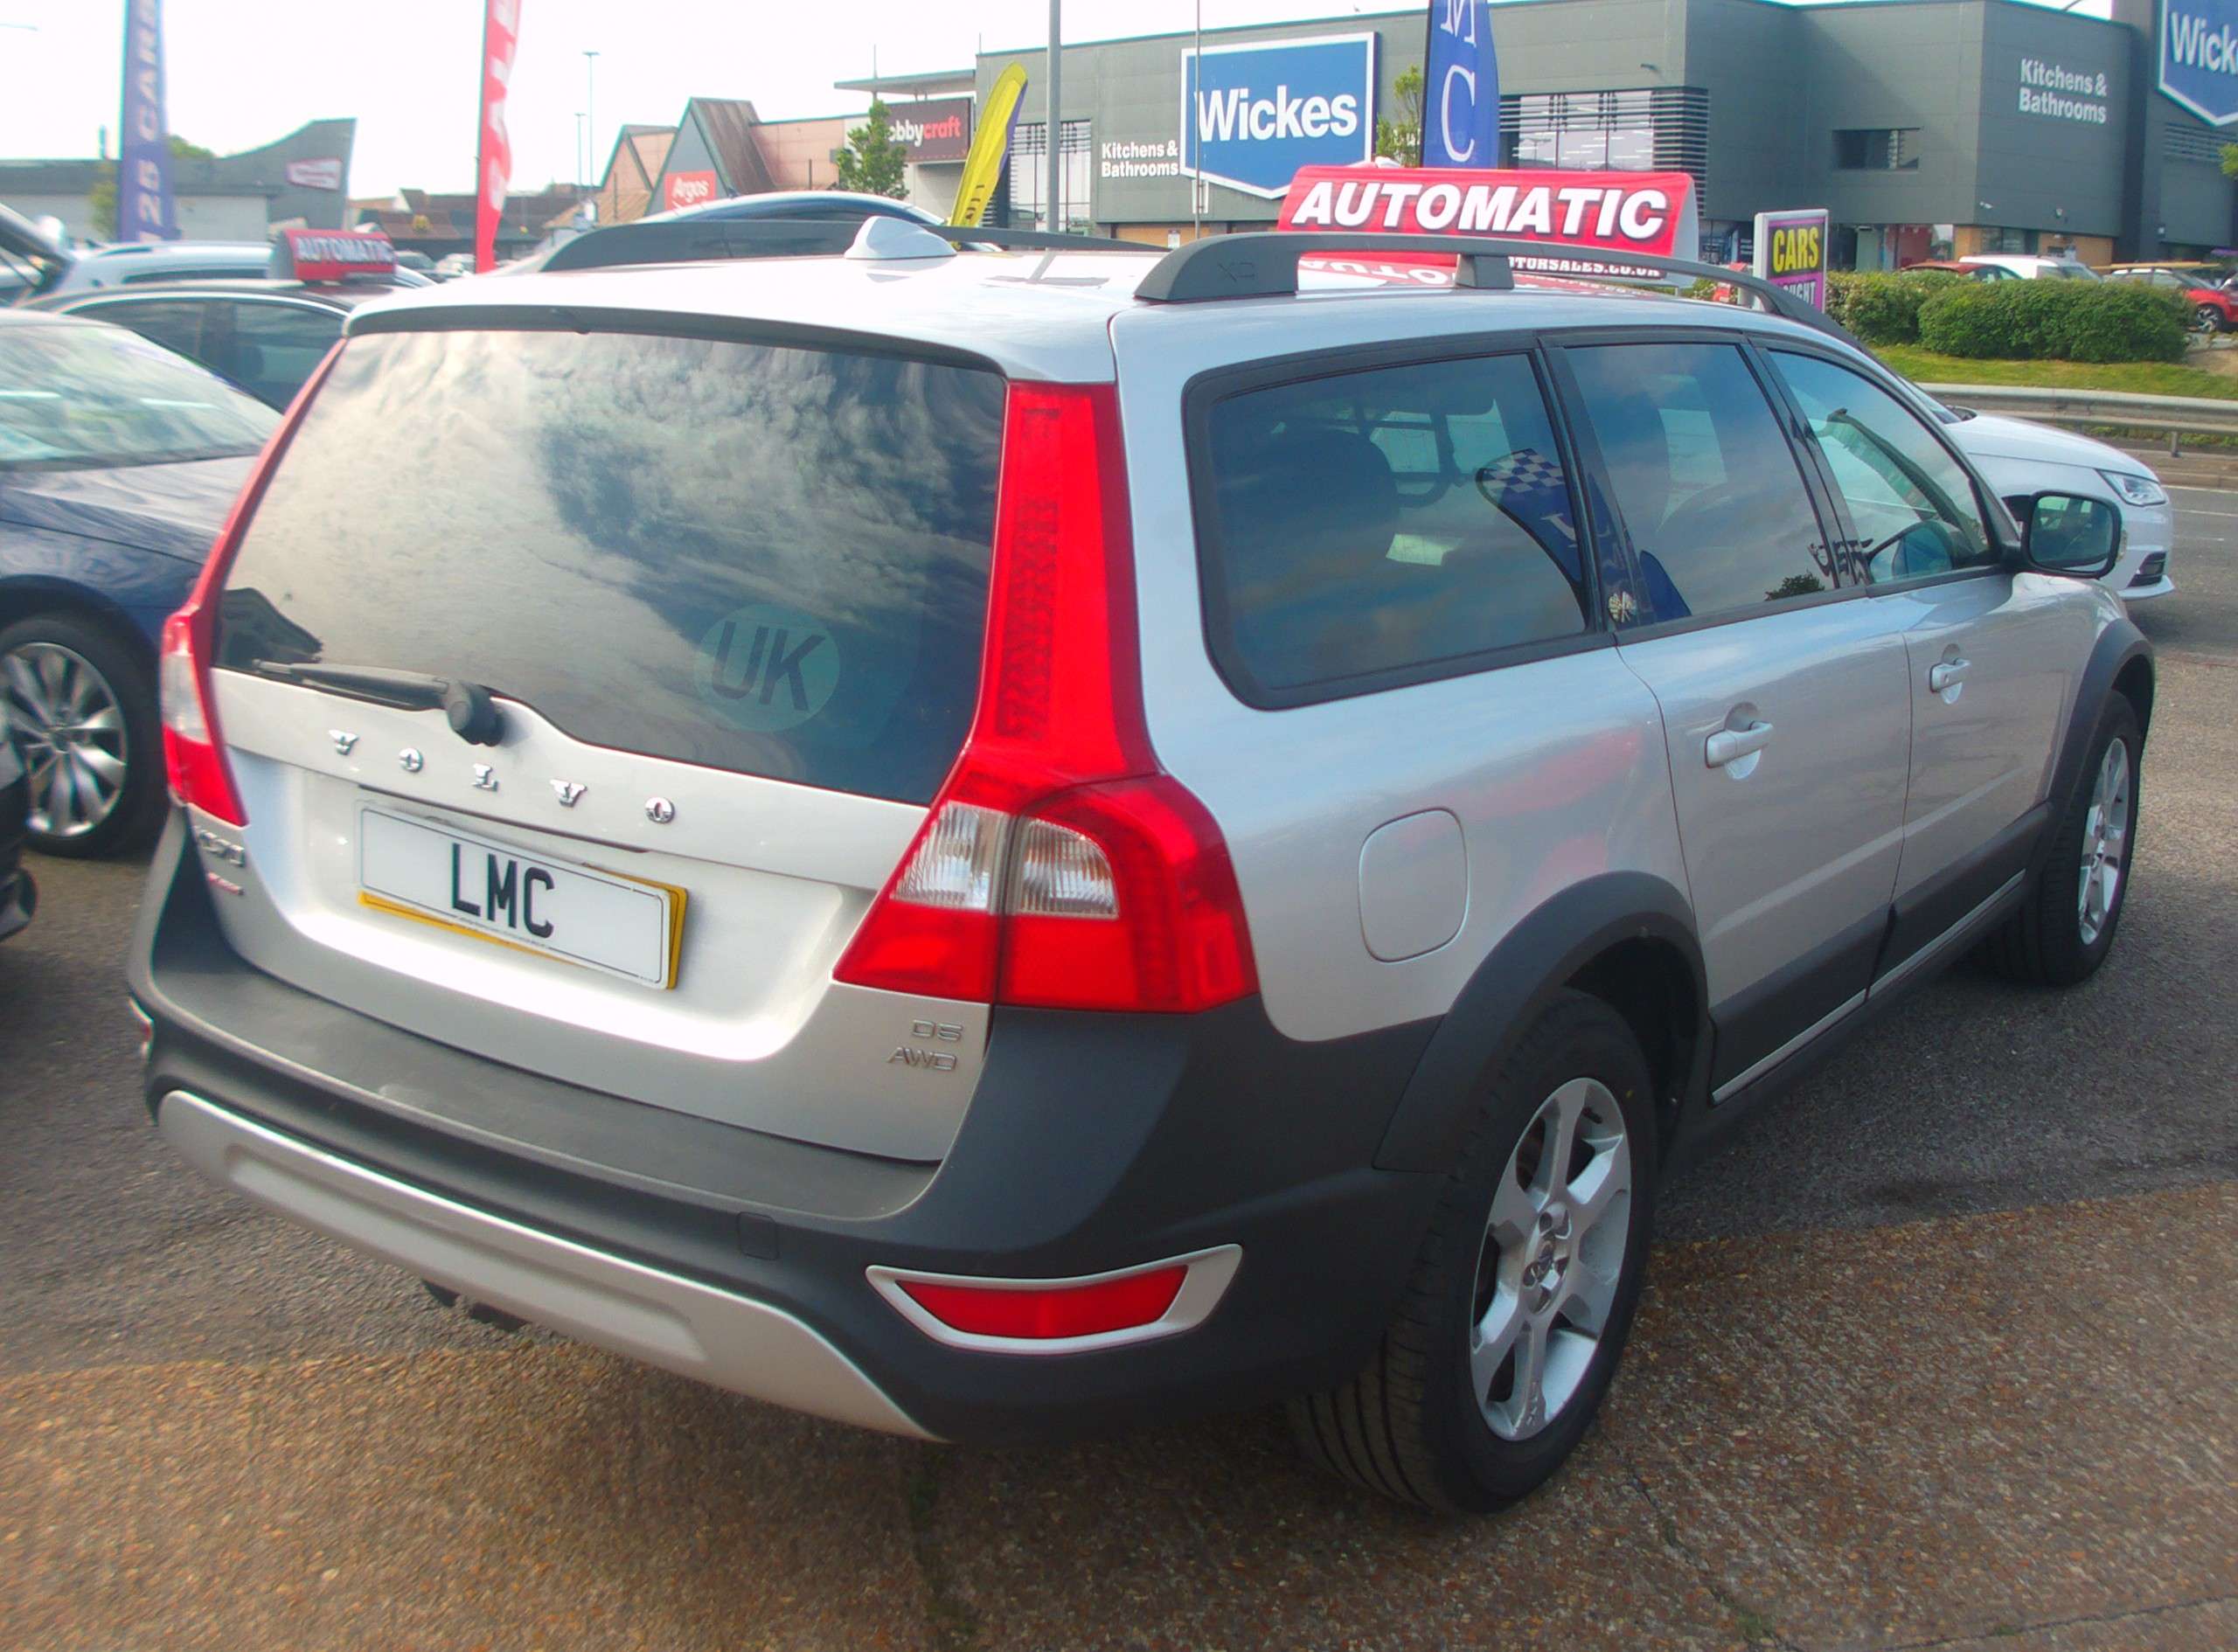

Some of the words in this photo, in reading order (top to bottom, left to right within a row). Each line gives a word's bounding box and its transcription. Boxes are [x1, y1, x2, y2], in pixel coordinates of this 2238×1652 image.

[2171, 11, 2238, 77] Wick
[2020, 58, 2094, 97] Kitchens
[1194, 85, 1358, 142] Wickes
[2019, 87, 2107, 124] Bathrooms
[887, 115, 961, 147] obbycraft
[1102, 141, 1164, 160] Kitchens
[1167, 140, 1178, 156] &
[671, 176, 710, 204] Argos
[1102, 161, 1178, 177] Bathrooms
[1290, 181, 1666, 239] AUTOMATIC
[1773, 227, 1819, 273] CARS
[712, 621, 826, 711] UK
[329, 729, 675, 823] VOLVO
[452, 843, 554, 939] LMC
[886, 1047, 956, 1070] AWD
